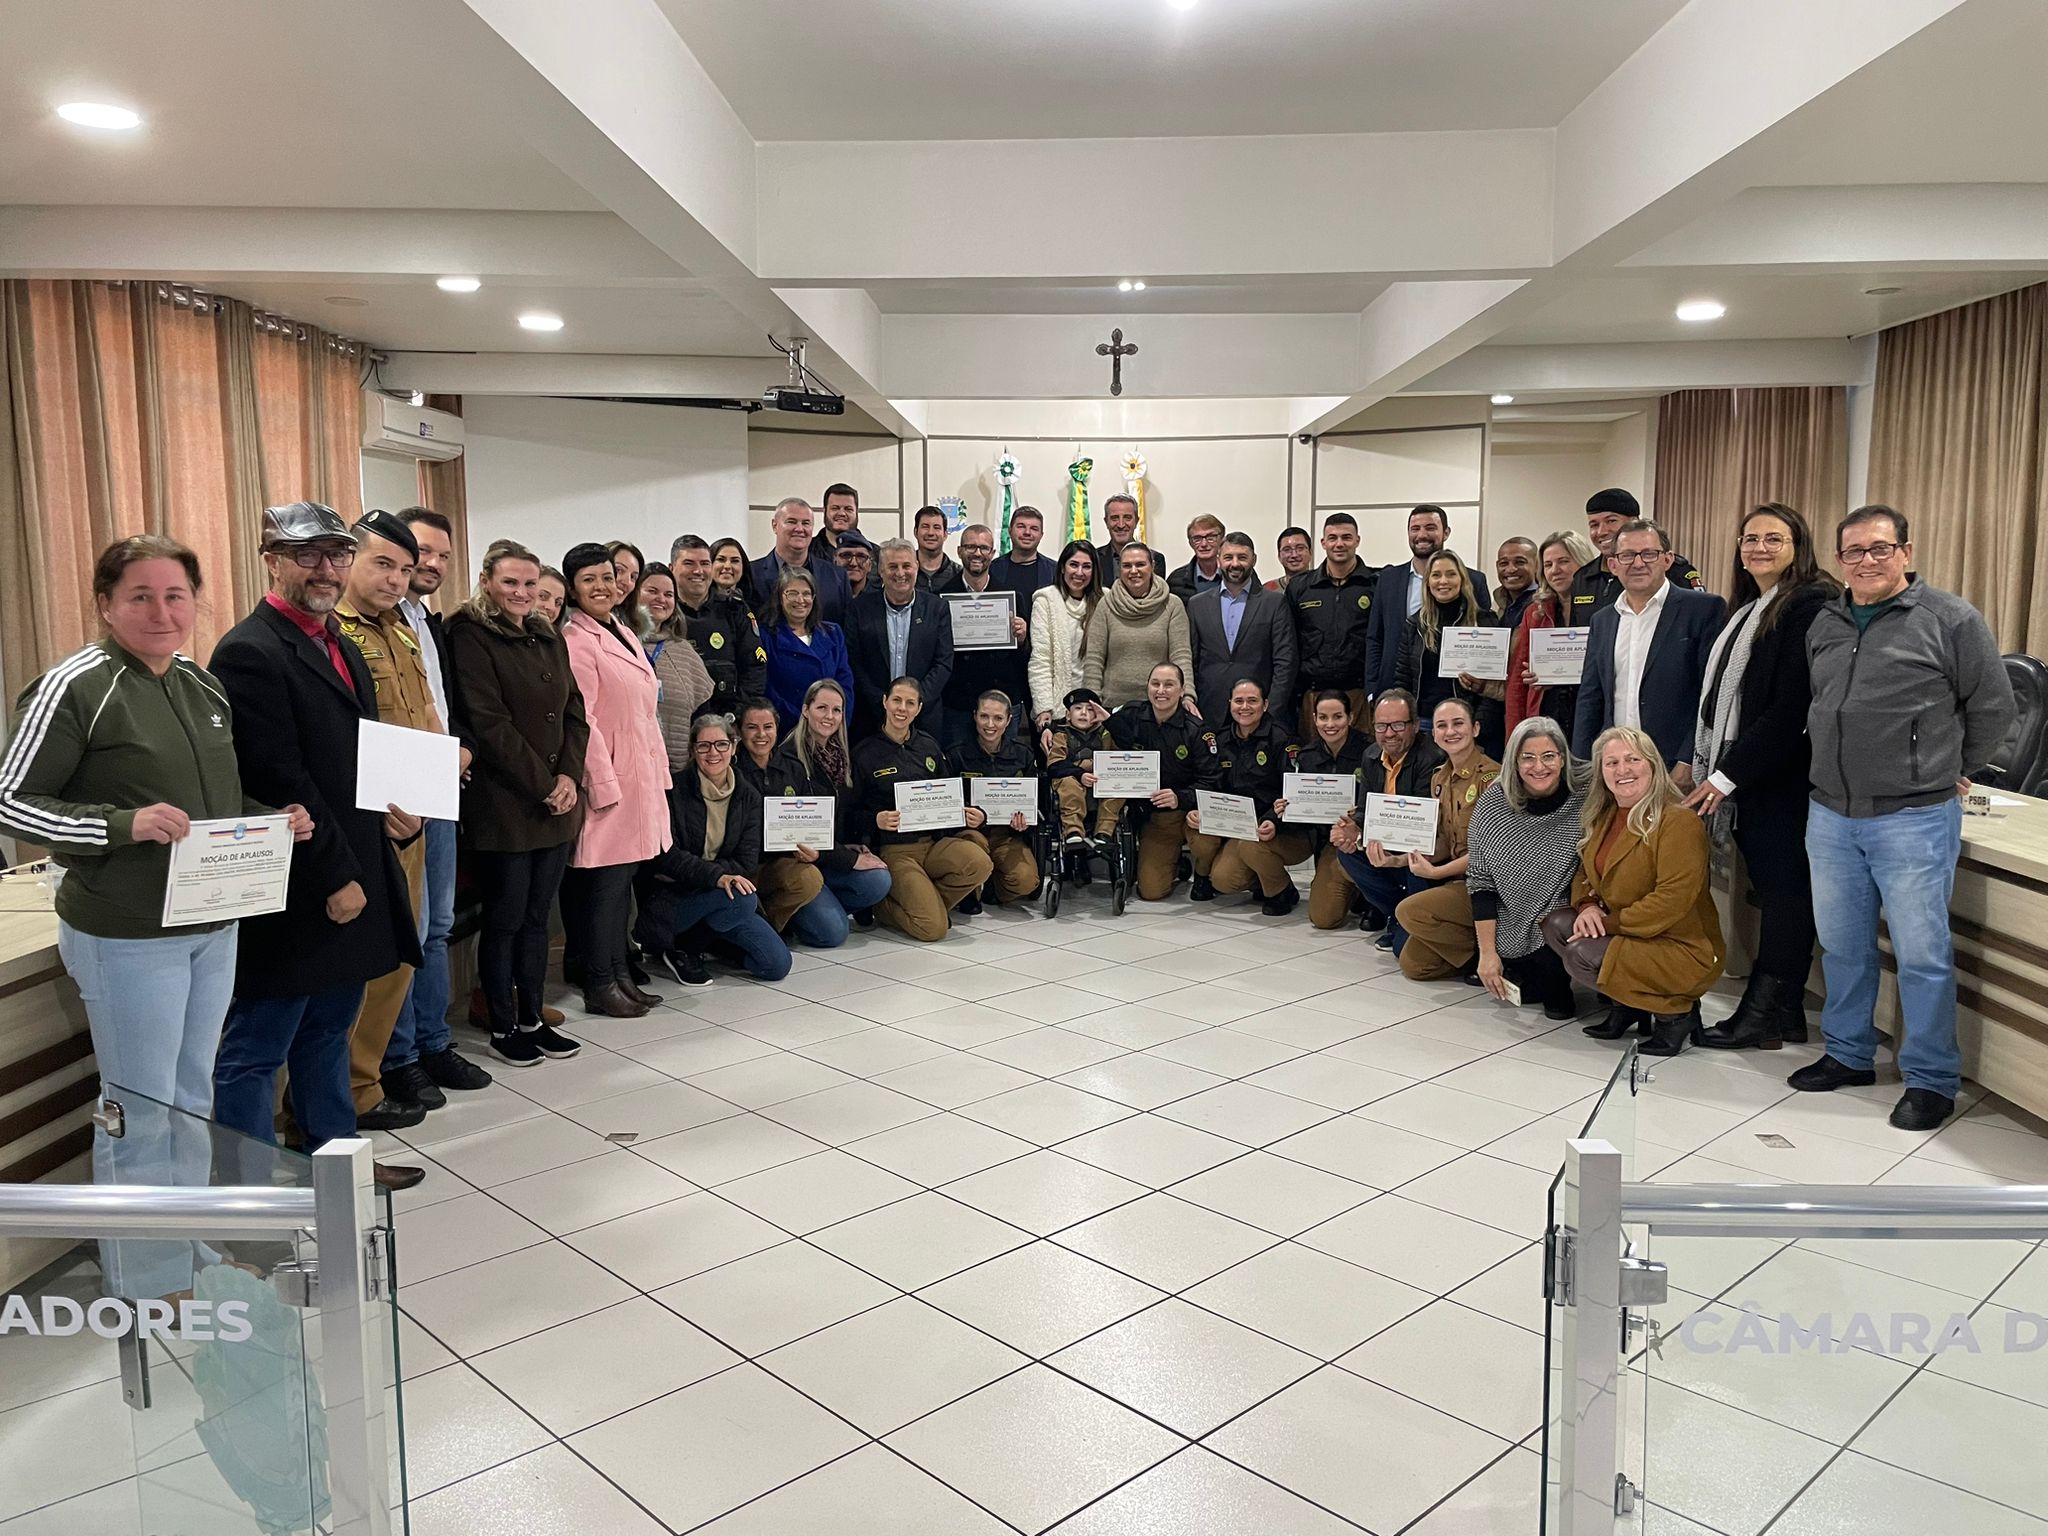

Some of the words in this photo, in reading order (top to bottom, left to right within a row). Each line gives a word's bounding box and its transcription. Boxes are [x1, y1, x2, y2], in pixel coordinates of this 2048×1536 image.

[201, 854, 228, 864] MOÇÃO
[240, 850, 273, 859] APLAUSOS
[0, 1294, 253, 1342] ADORES
[1680, 1300, 1981, 1354] CÂMARA
